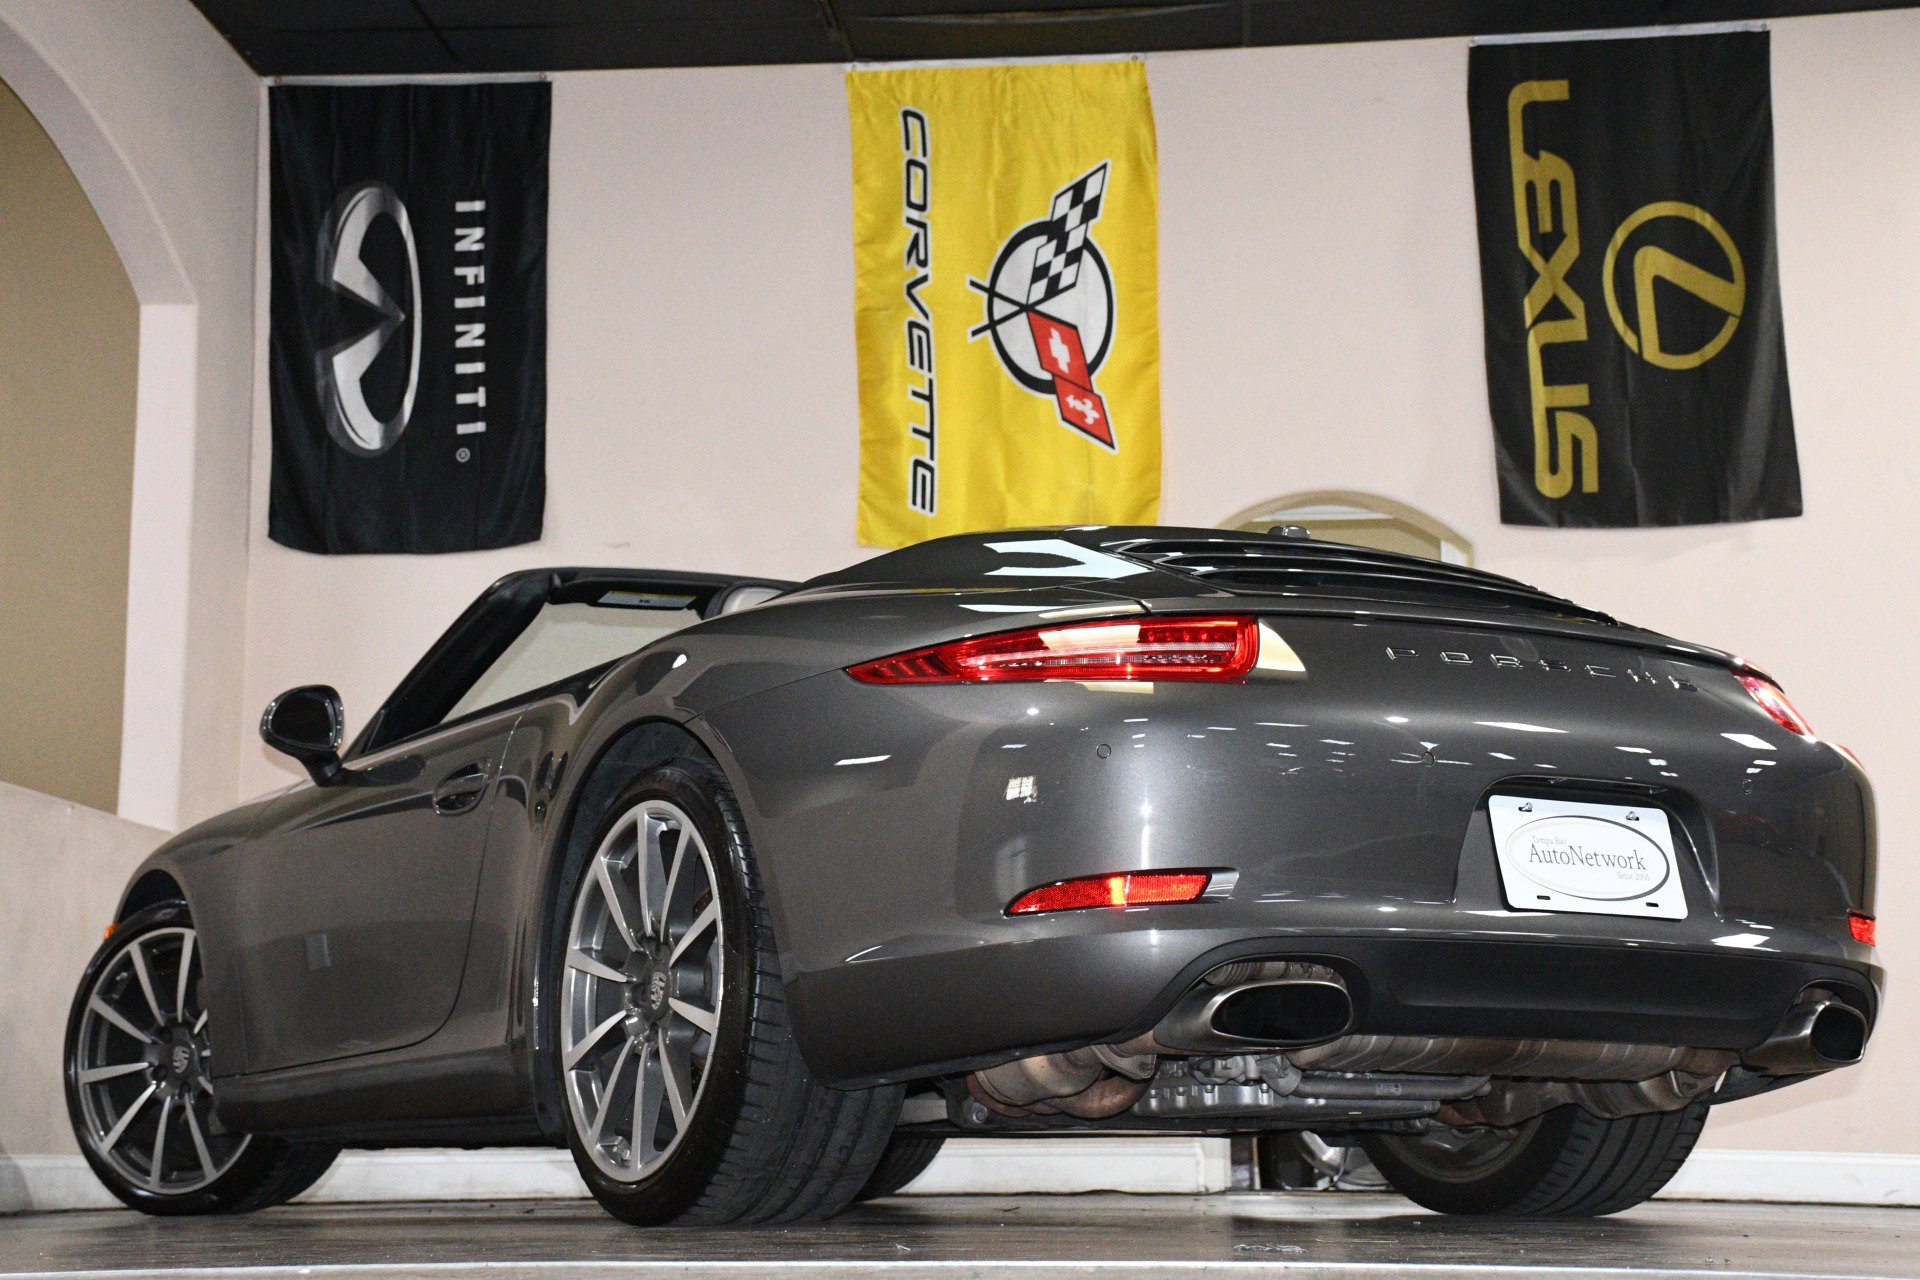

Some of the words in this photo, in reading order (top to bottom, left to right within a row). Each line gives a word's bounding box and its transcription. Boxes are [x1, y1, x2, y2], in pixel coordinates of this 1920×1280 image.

[454, 200, 487, 435] INFINITI
[902, 108, 935, 514] CORVETTE
[1507, 79, 1599, 499] LEXUS
[1385, 646, 1700, 692] PORSCHE
[1529, 842, 1648, 870] AutoNetwork
